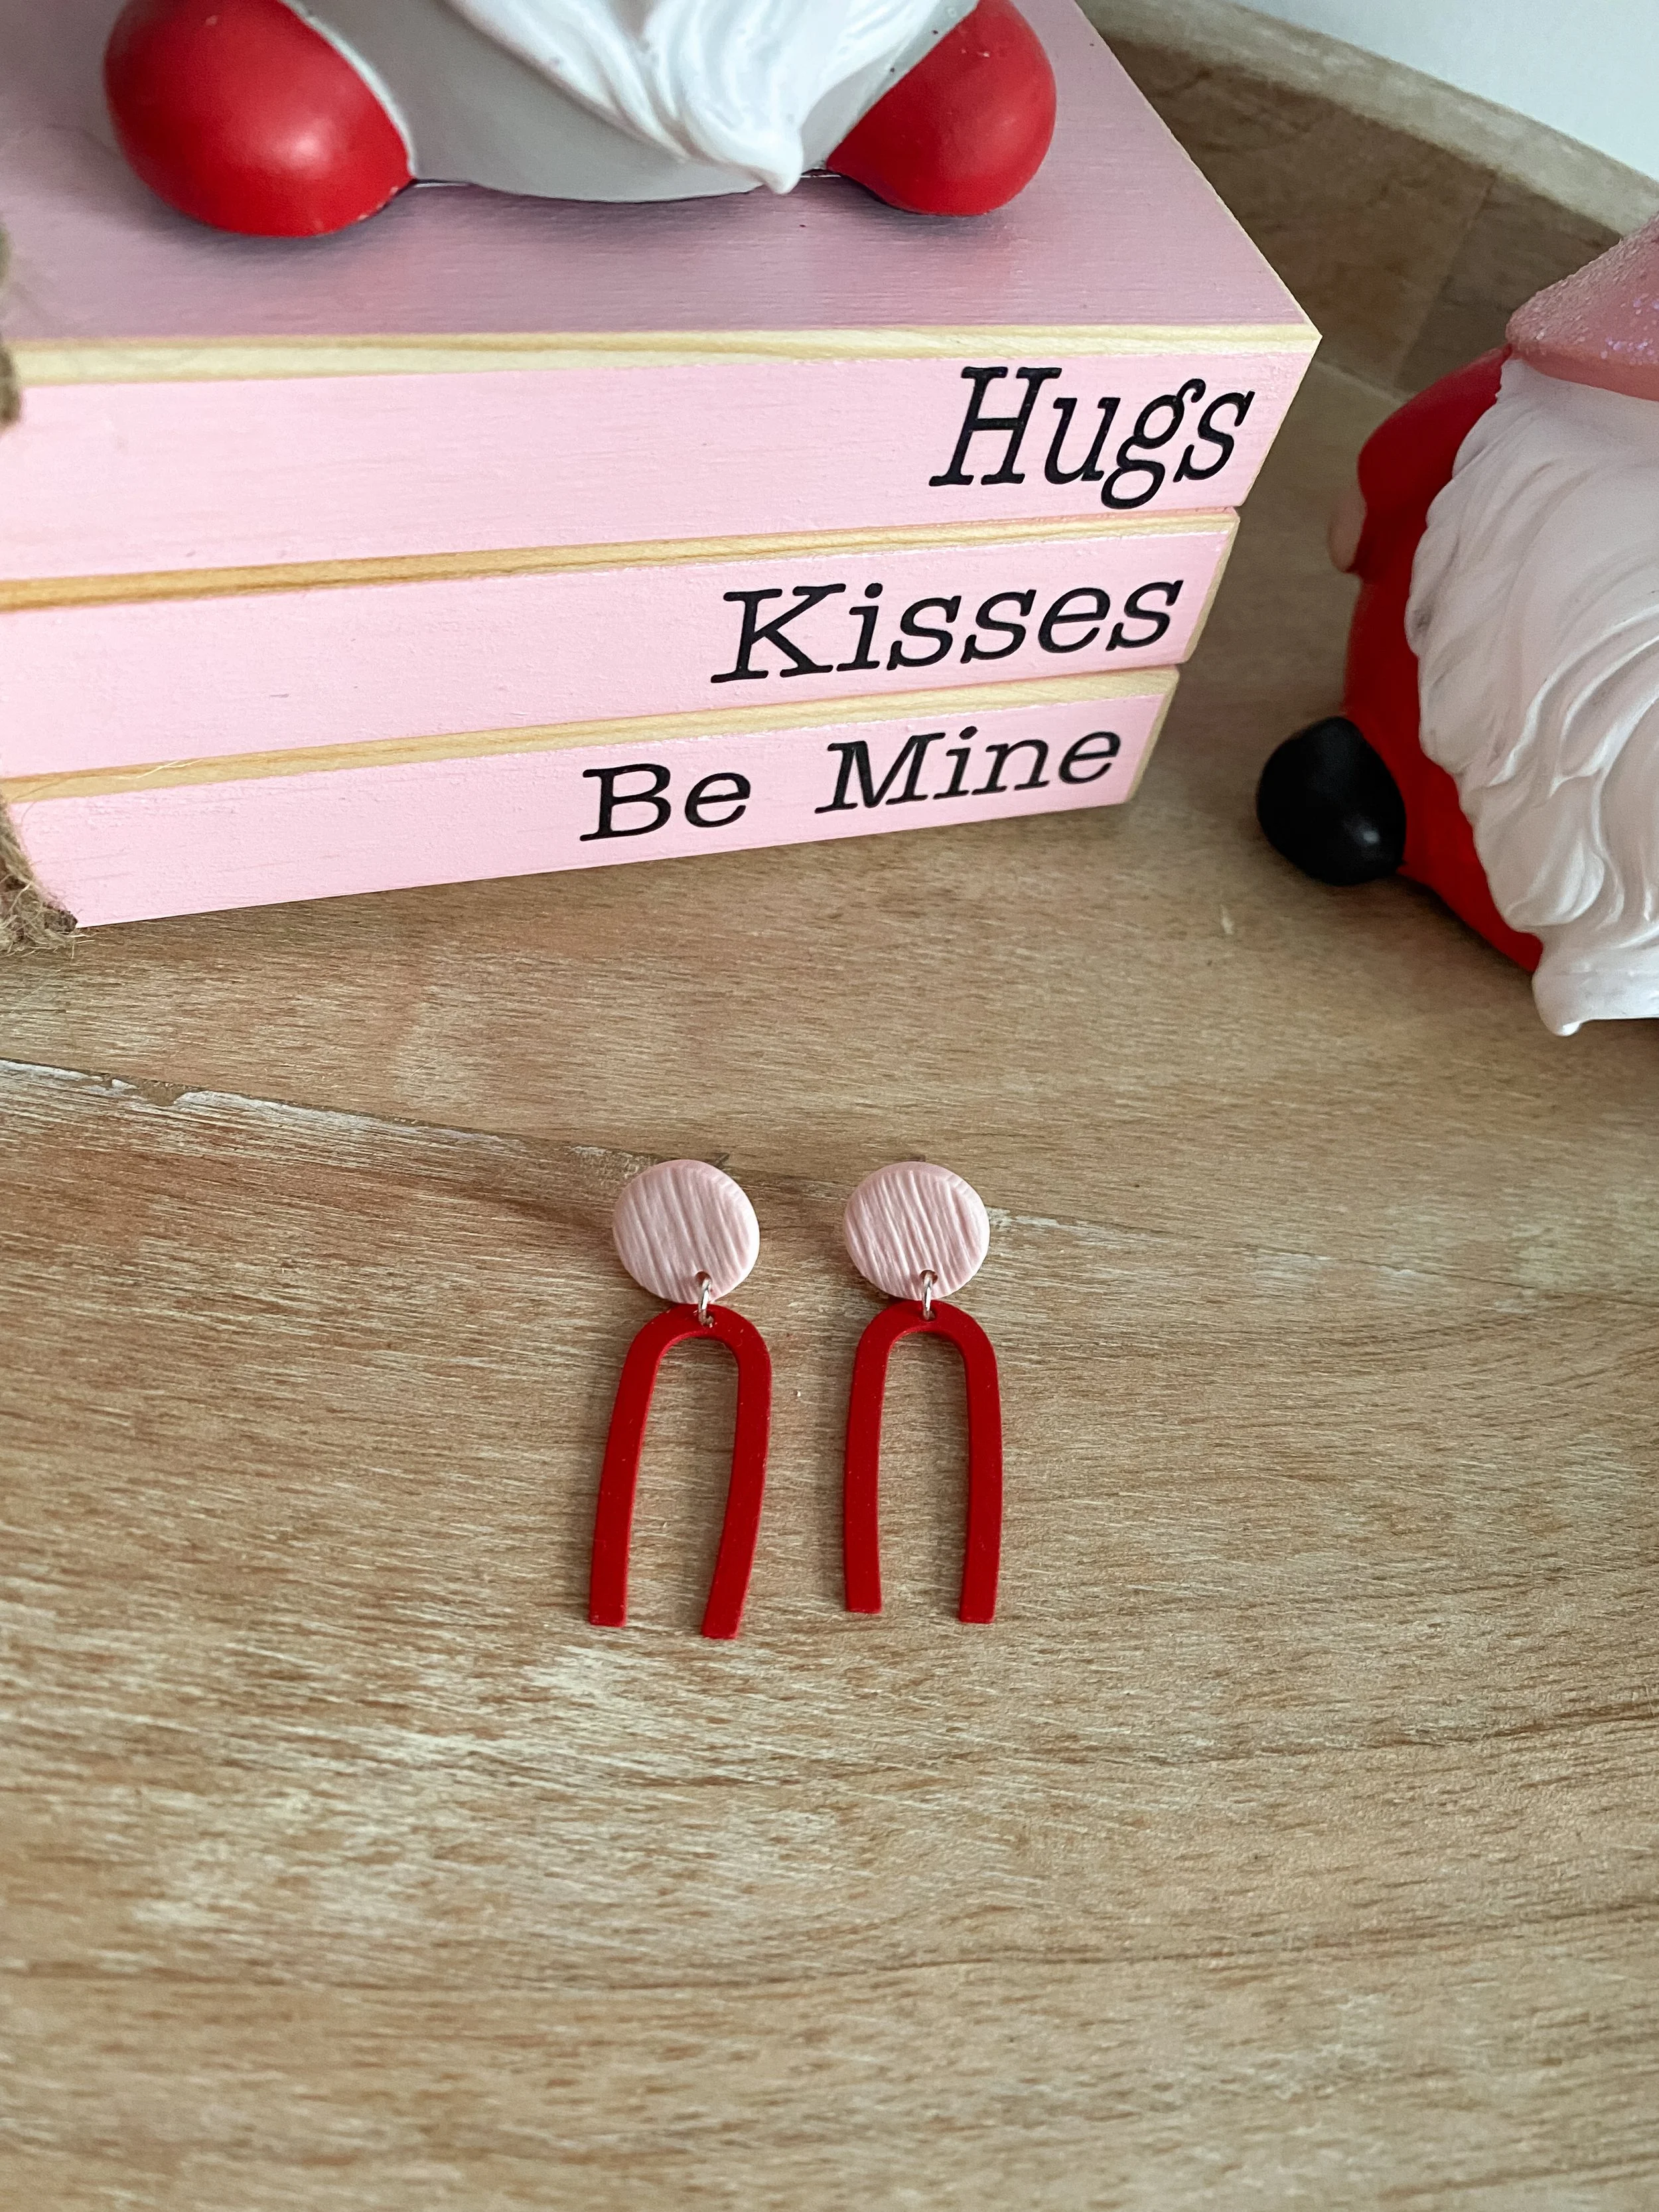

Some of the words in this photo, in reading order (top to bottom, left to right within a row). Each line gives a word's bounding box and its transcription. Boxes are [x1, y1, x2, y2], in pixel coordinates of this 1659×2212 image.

[928, 366, 1256, 510] Hugs
[710, 579, 1184, 684] Kisses
[579, 763, 751, 842] Be
[814, 725, 1121, 814] Mine
